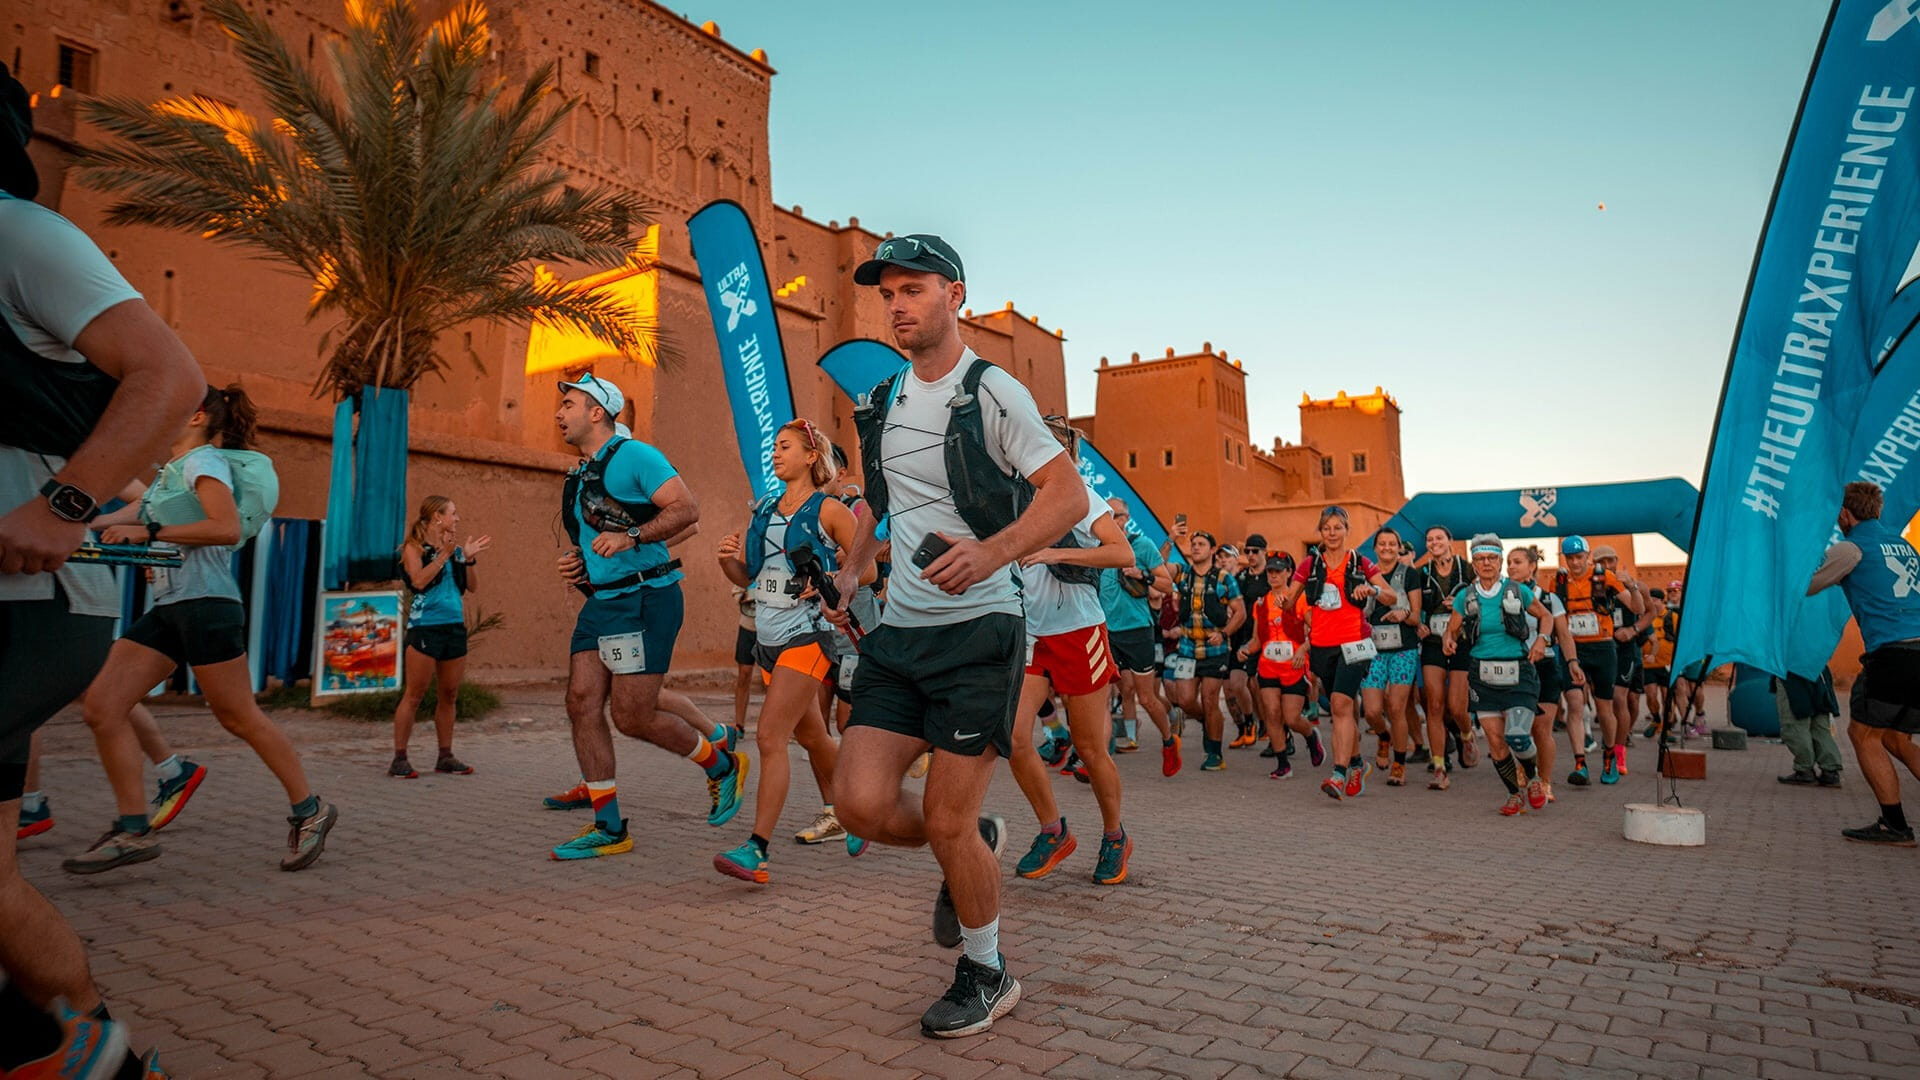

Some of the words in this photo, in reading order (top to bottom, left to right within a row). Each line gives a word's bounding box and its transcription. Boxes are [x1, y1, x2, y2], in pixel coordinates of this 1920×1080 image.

[717, 262, 748, 293] ULTRA
[1742, 84, 1916, 520] #THEULTRAXPERIENCE
[1880, 543, 1917, 557] ULTRA
[765, 579, 777, 593] 139
[612, 648, 623, 661] 55
